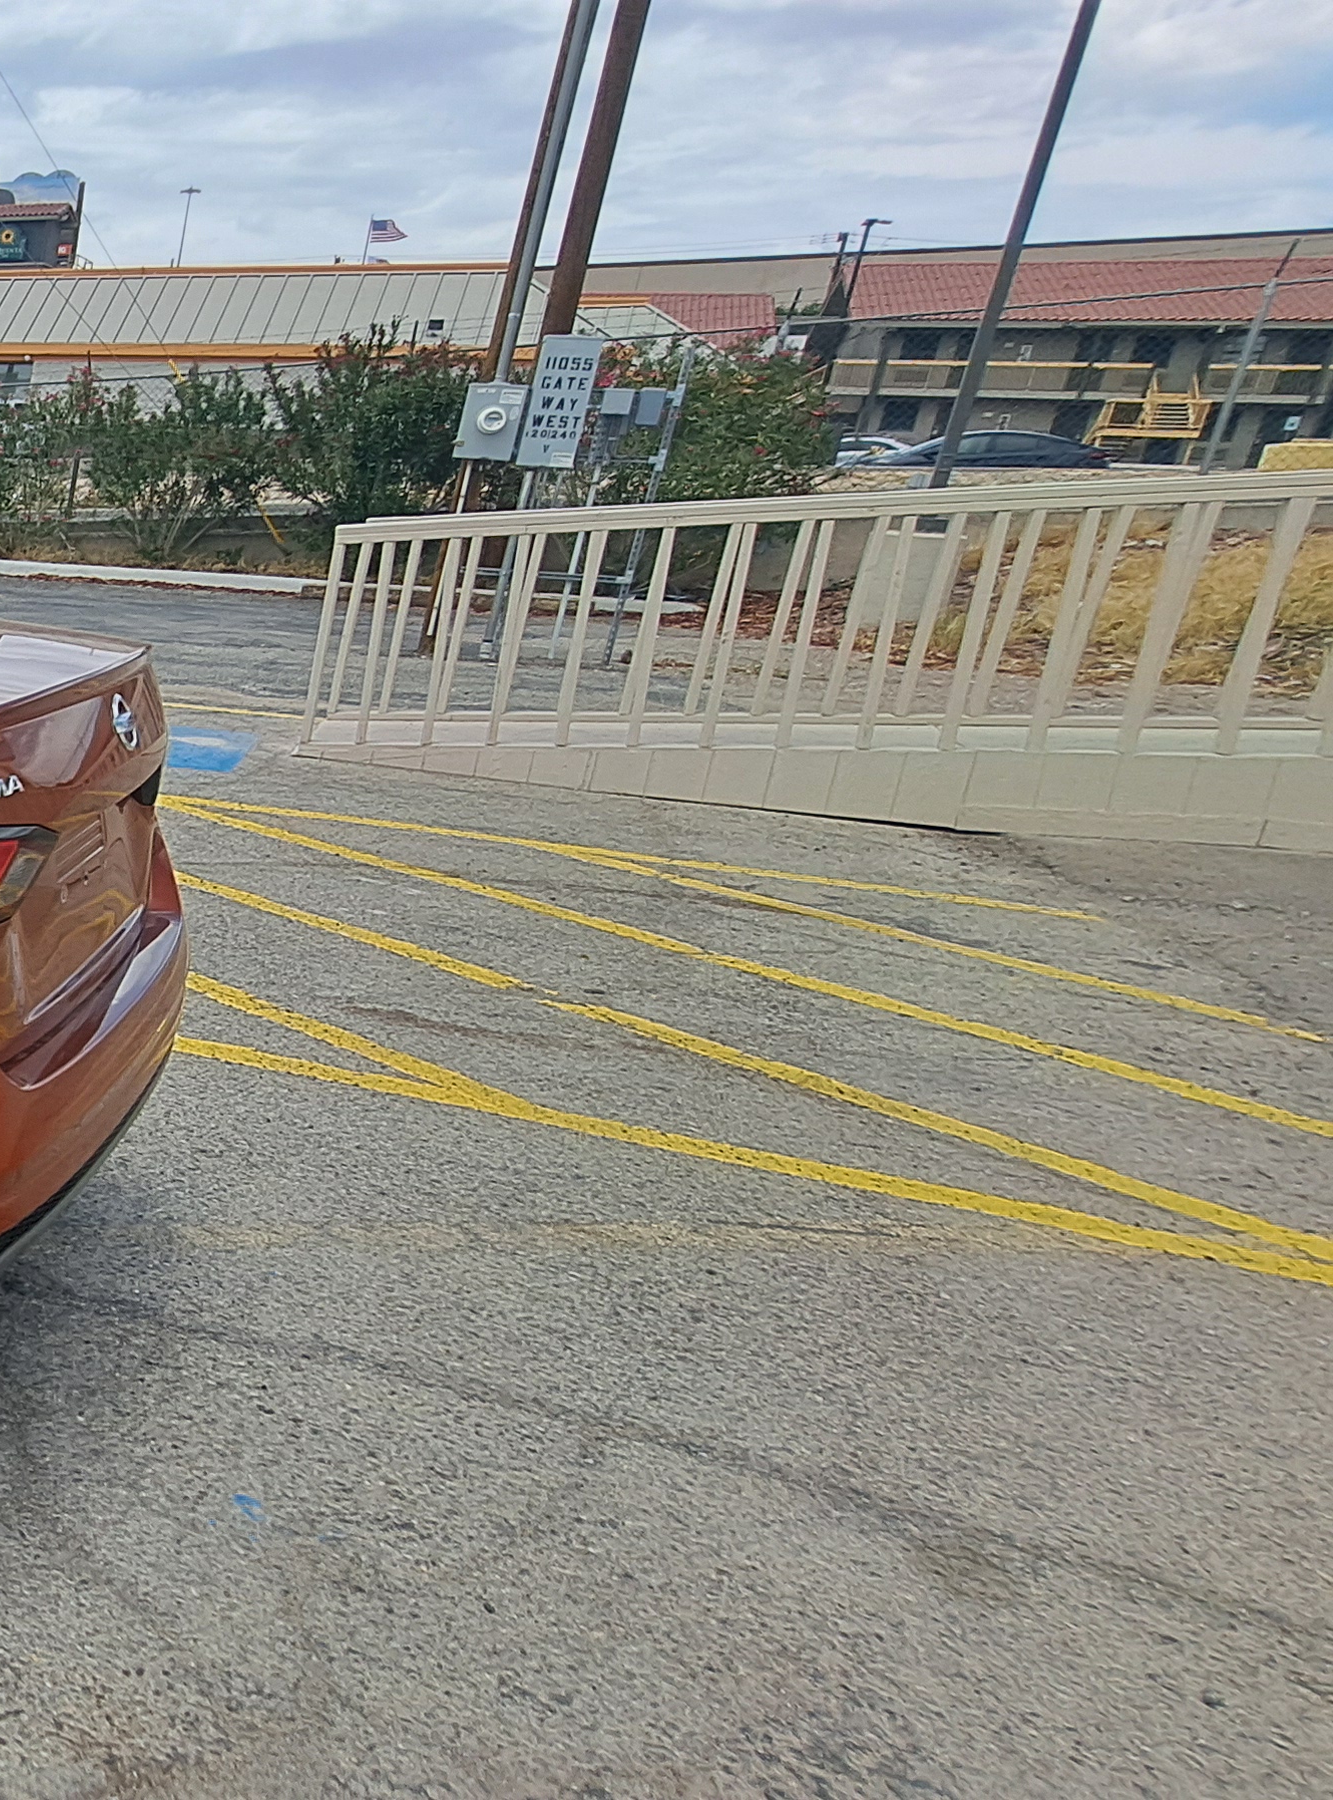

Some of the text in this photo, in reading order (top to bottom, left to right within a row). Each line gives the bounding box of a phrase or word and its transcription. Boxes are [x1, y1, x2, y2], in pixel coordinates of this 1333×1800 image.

[545, 356, 594, 371] 11055
[541, 376, 589, 391] GATE
[541, 396, 578, 411] WAY
[532, 414, 581, 429] WEST
[543, 445, 550, 453] V
